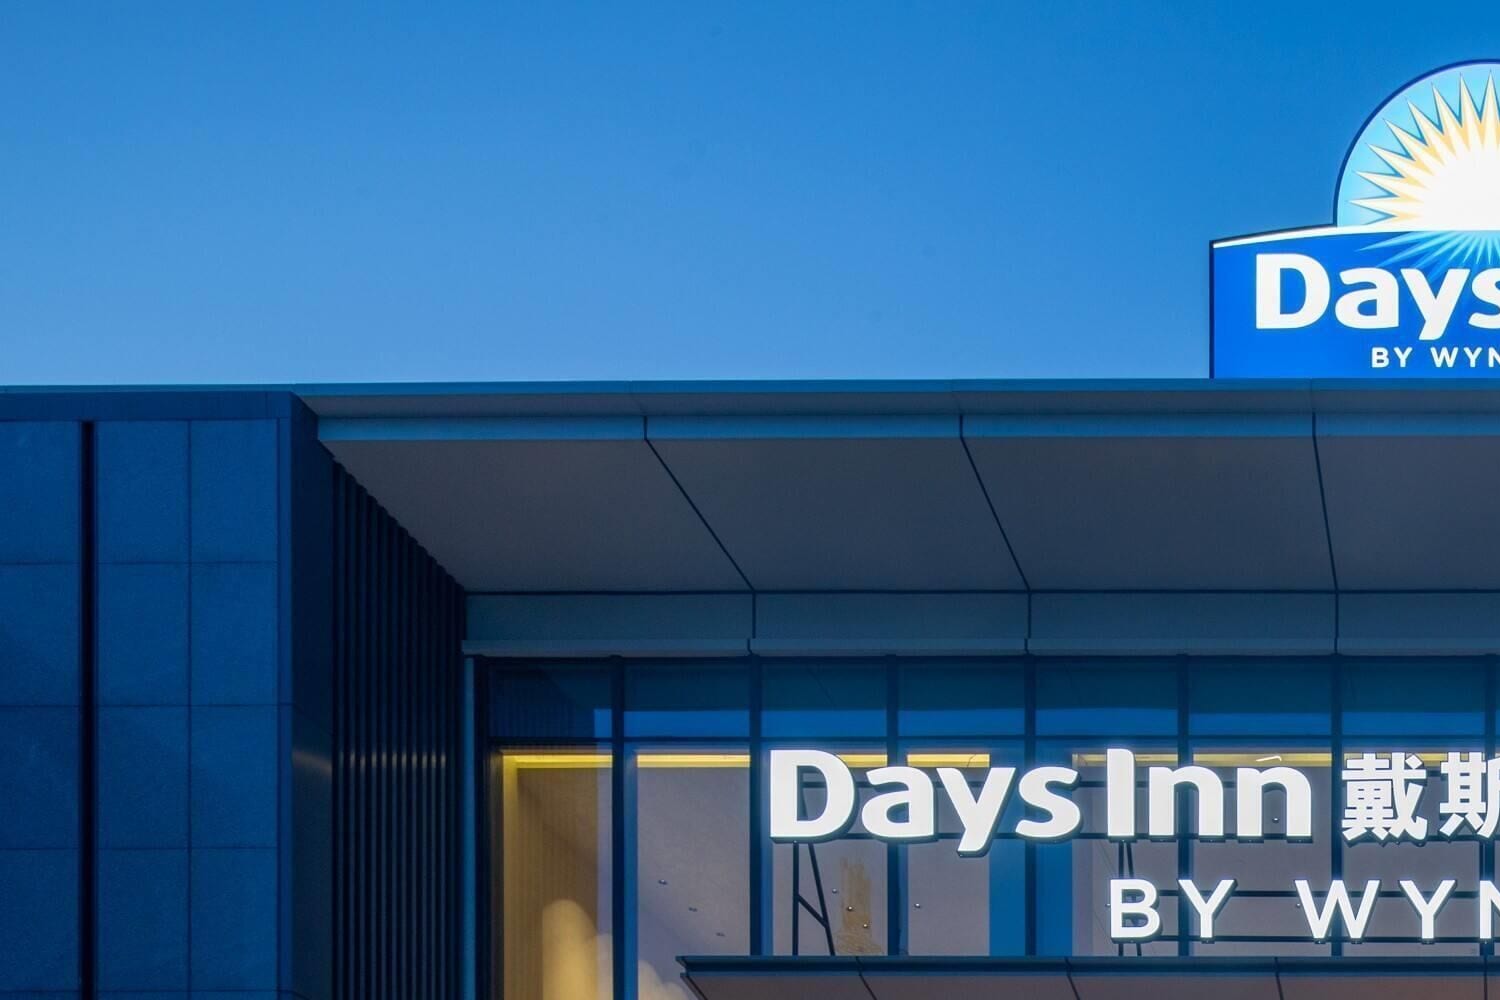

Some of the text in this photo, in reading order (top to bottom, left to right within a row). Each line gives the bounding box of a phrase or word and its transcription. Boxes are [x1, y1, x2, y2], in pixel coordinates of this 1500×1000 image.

[1371, 347, 1413, 369] BY
[769, 748, 1083, 858] Days
[1106, 747, 1314, 843] Inn
[1109, 878, 1238, 943] BY
